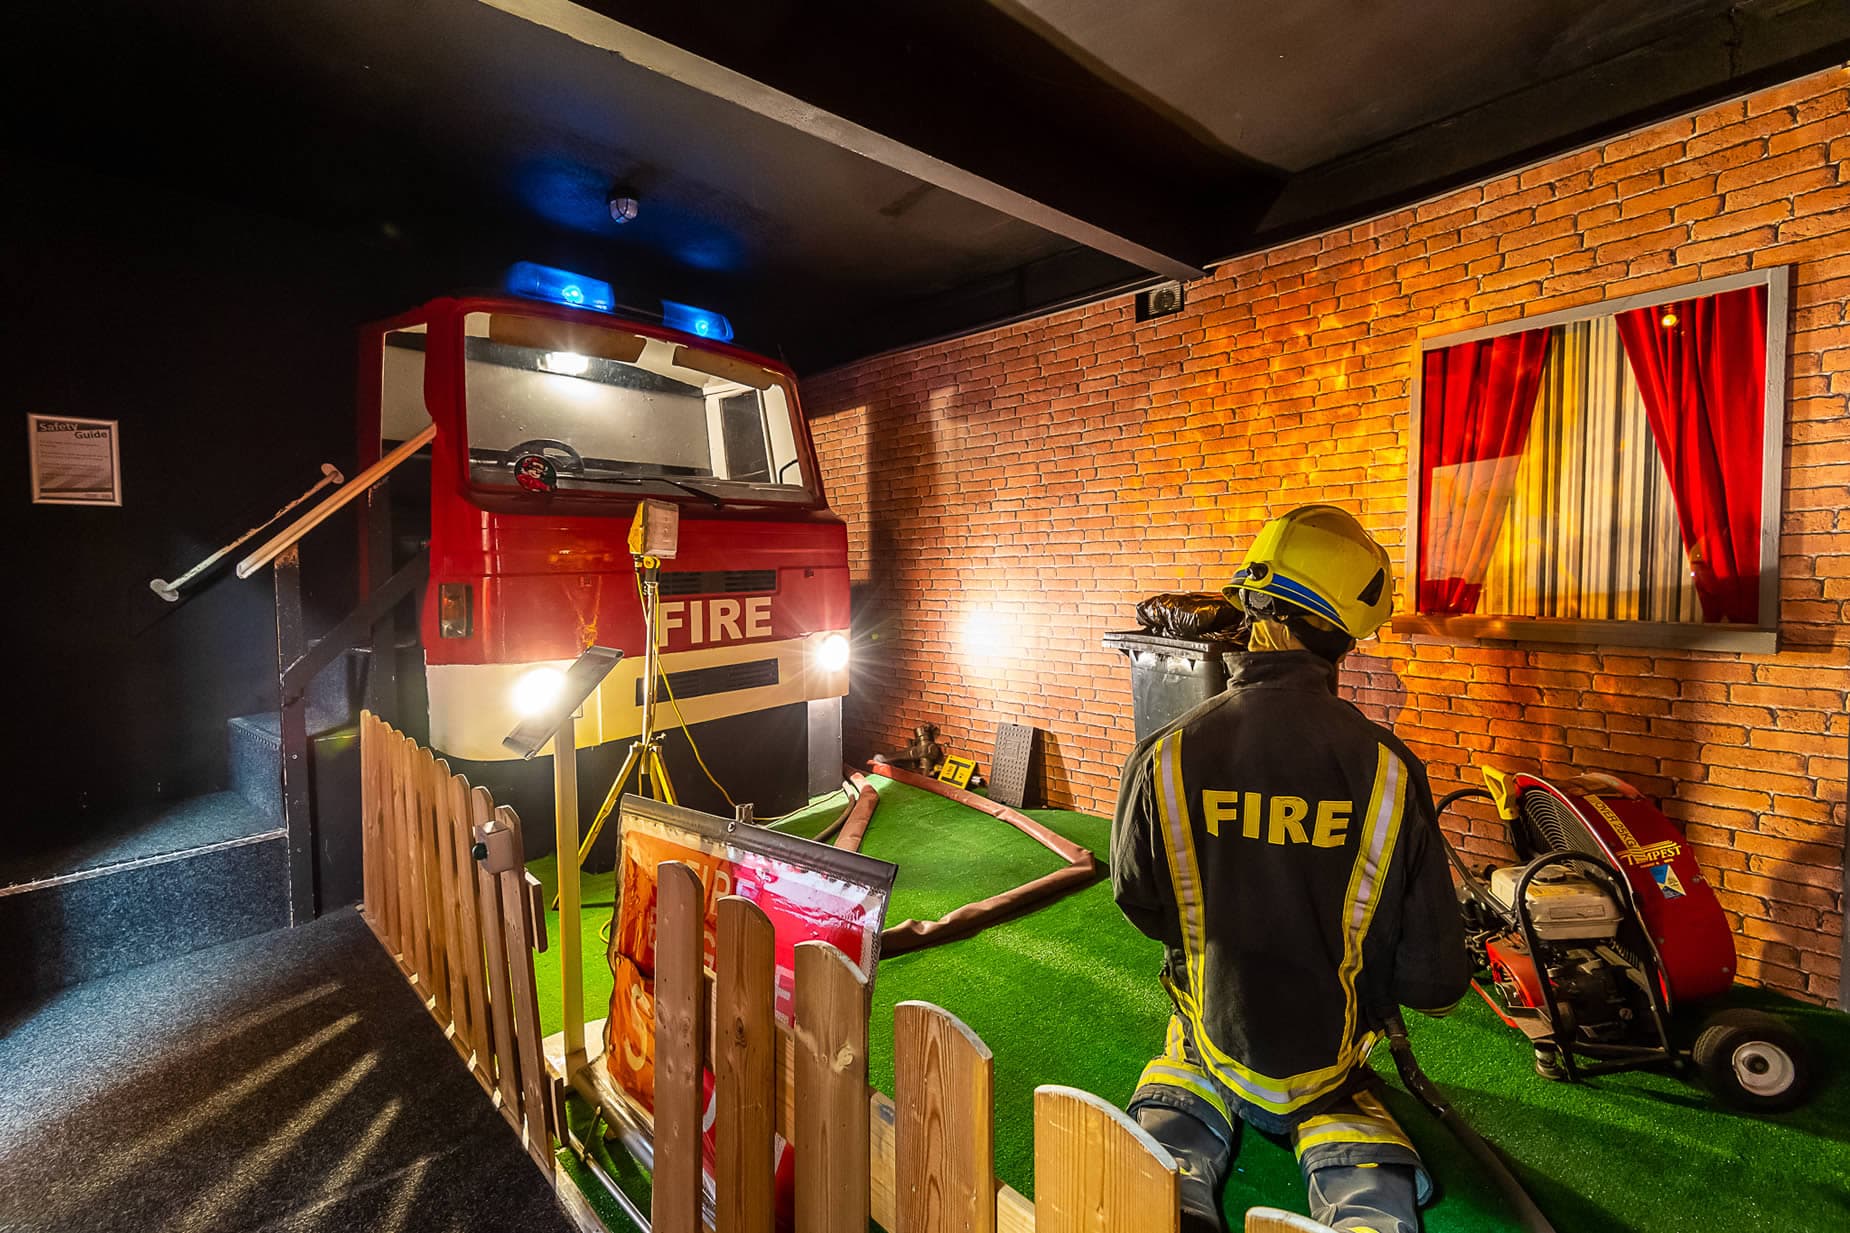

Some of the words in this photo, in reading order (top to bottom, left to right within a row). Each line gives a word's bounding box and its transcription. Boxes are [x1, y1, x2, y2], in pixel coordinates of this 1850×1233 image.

[40, 422, 79, 432] Safety
[74, 431, 108, 439] Guide
[659, 597, 772, 648] FIRE
[1202, 789, 1353, 848] FIRE
[1595, 799, 1618, 823] OVER
[1615, 823, 1637, 850] 25KG
